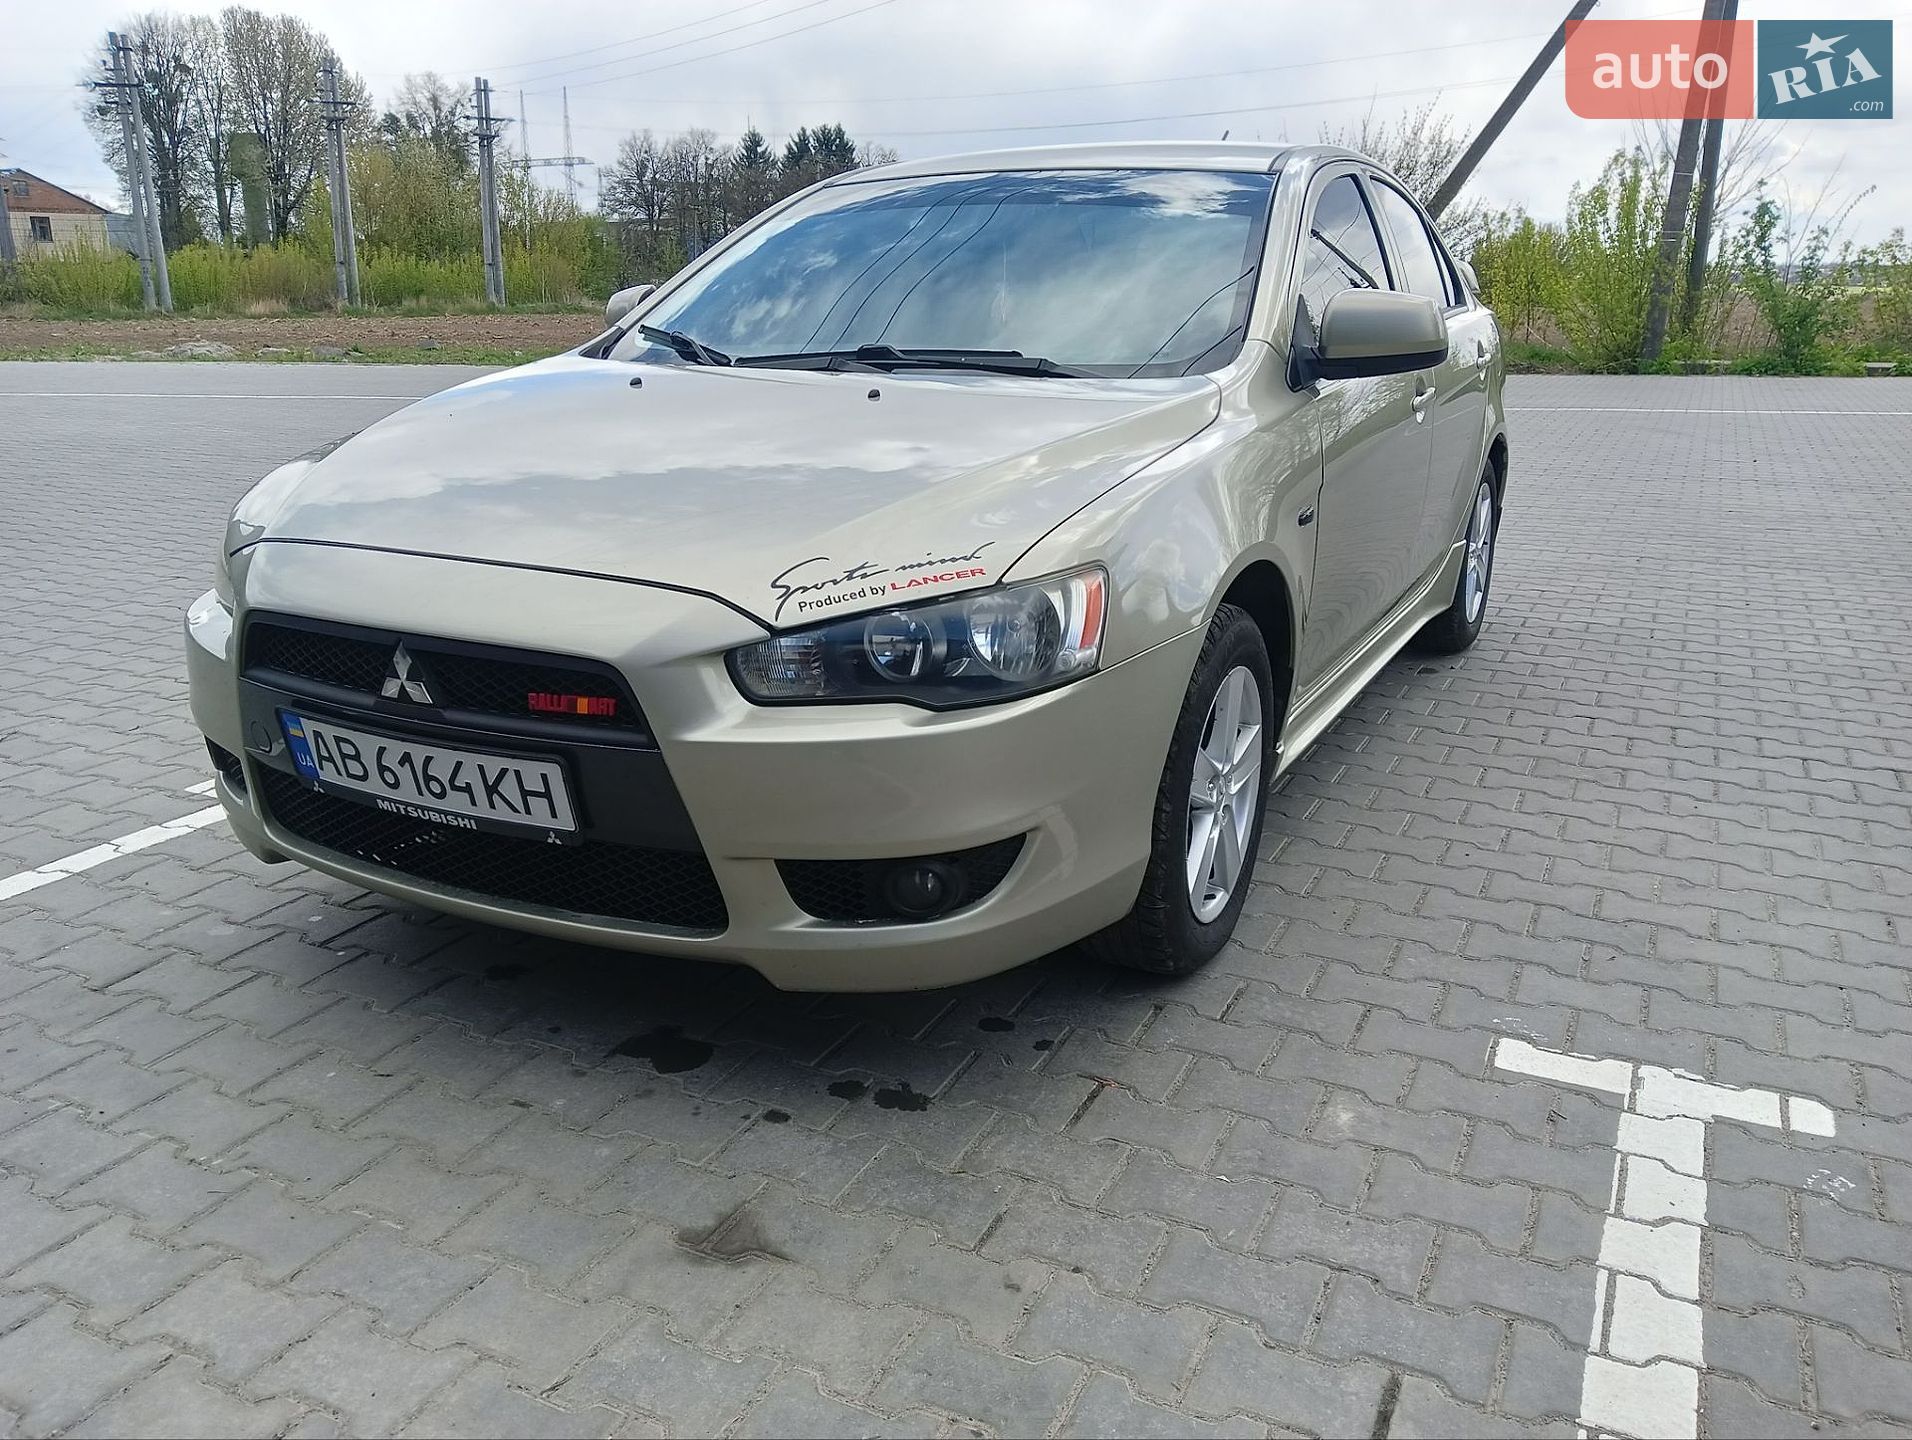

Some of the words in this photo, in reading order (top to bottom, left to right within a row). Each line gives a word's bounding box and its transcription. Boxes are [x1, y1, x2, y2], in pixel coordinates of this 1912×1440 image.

[798, 589, 867, 613] Produced
[869, 583, 887, 596] by
[890, 567, 987, 591] LANCER
[296, 752, 315, 769] UA
[376, 799, 478, 831] MITSUBISHI
